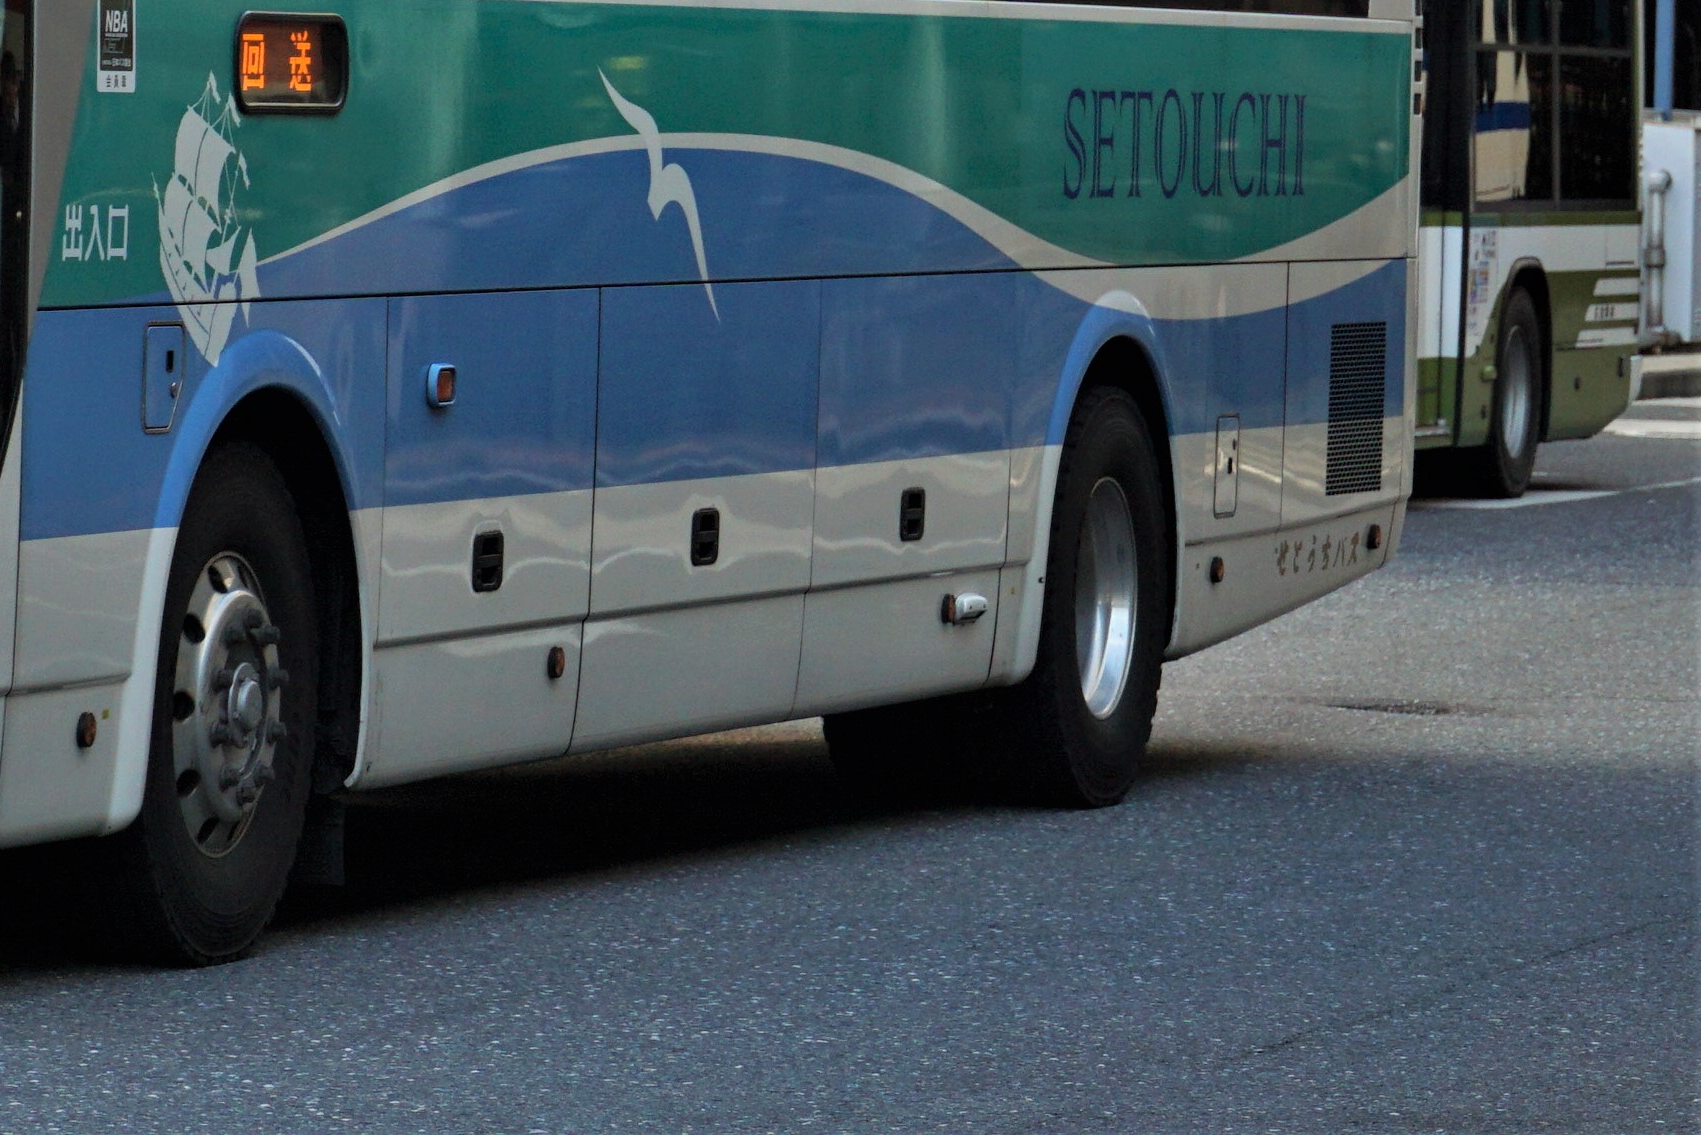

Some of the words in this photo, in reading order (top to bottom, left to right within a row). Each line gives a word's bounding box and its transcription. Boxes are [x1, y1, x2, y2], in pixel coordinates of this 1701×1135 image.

[105, 10, 128, 33] NBA
[241, 30, 312, 92] 回送
[1063, 87, 1307, 201] SETOUCHI
[62, 203, 129, 262] 出入口
[1275, 531, 1360, 576] せとうちバス
